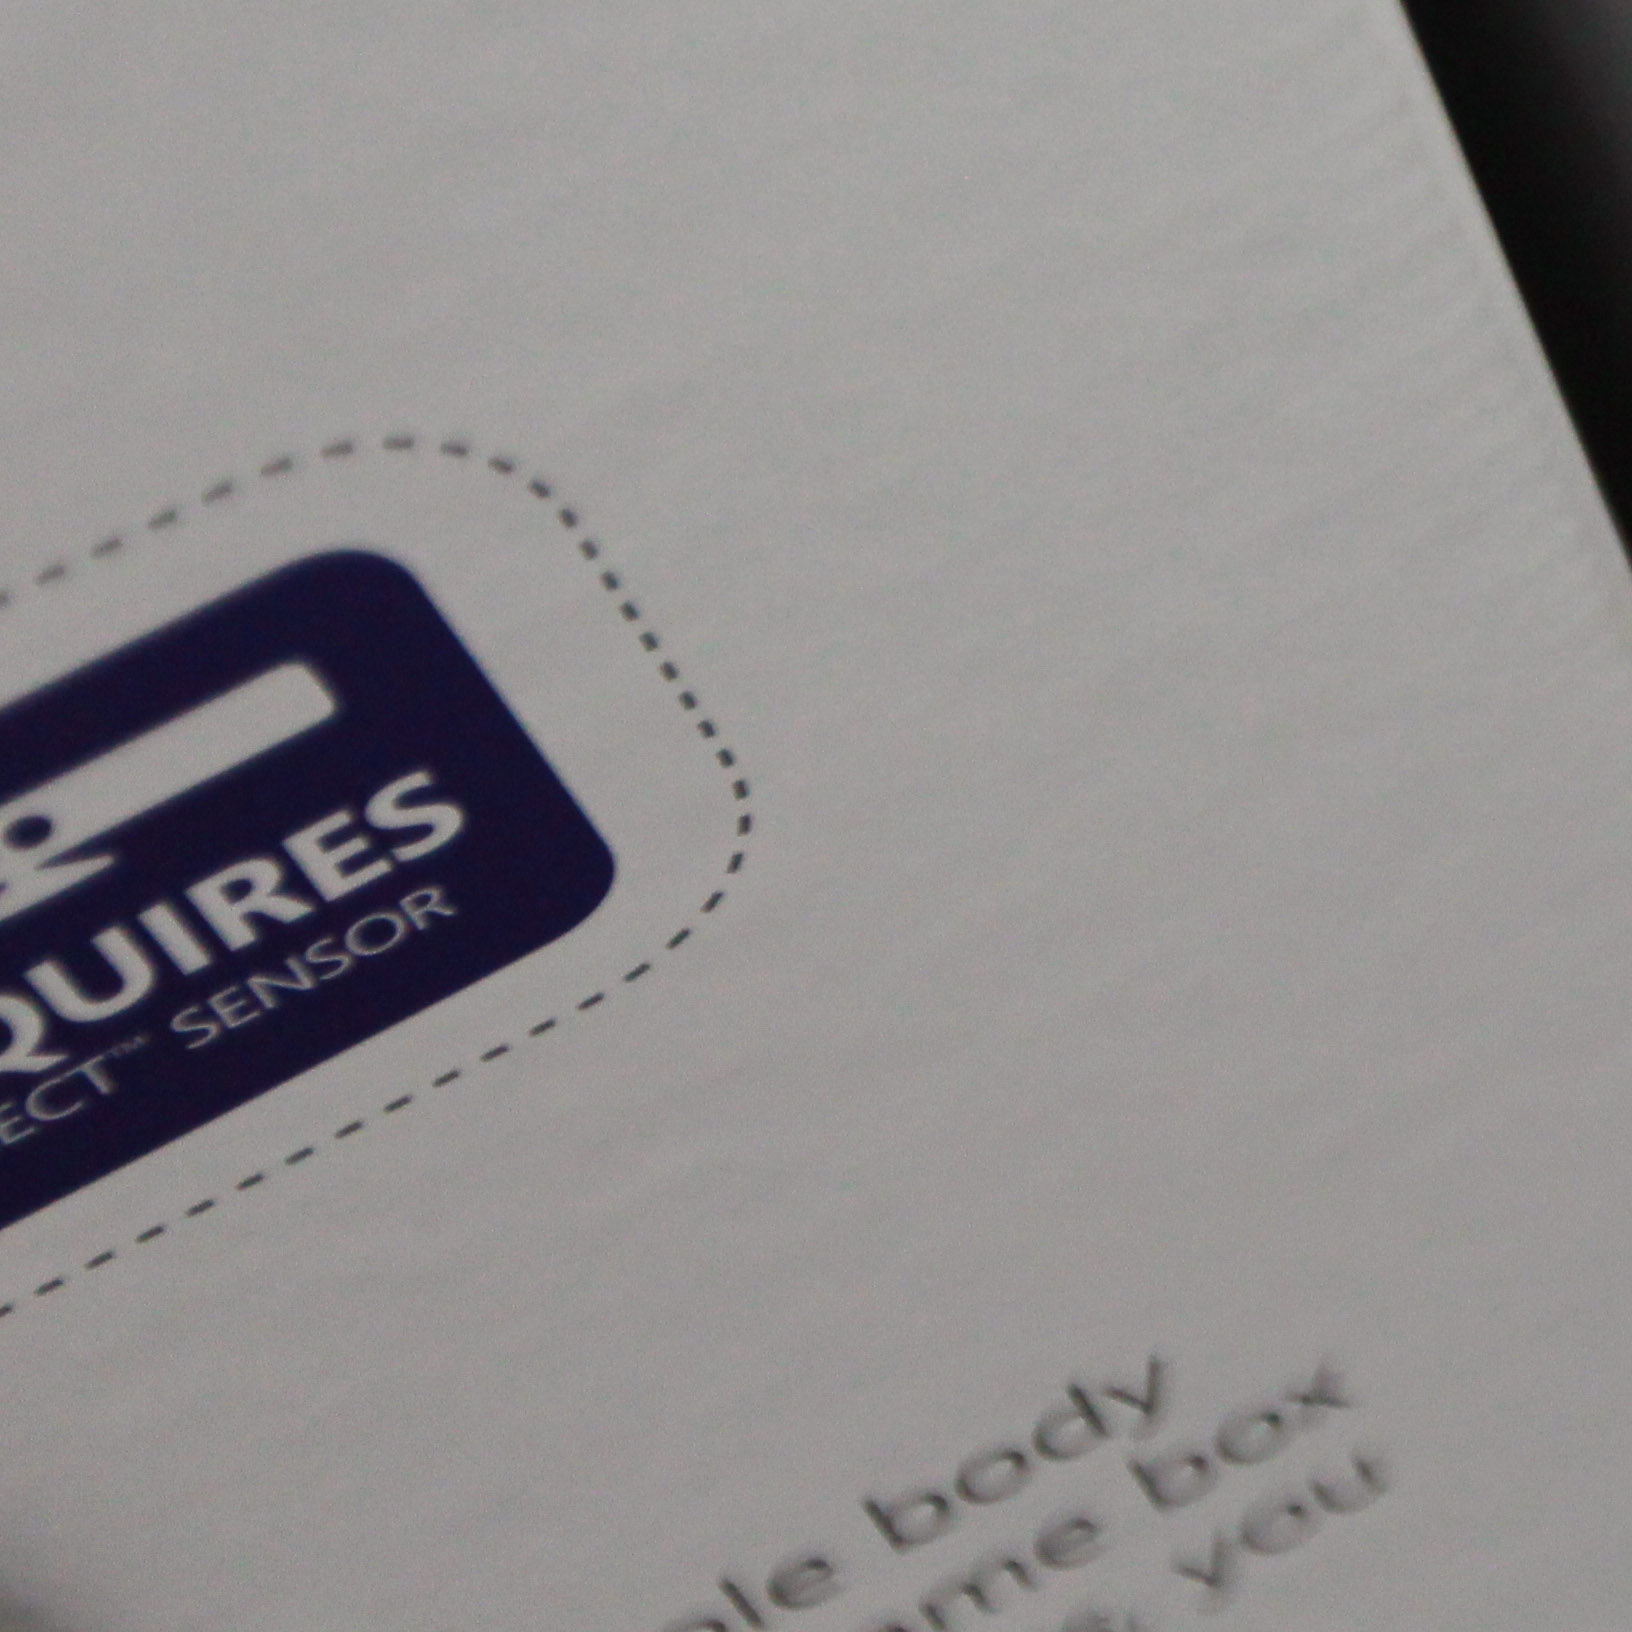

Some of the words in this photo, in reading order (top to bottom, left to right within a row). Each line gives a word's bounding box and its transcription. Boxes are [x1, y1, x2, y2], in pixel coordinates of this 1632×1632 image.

[169, 884, 458, 1050] SENSOR
[660, 1555, 845, 1632] le
[864, 1355, 1168, 1553] body
[872, 1513, 1104, 1632] me
[1129, 1363, 1352, 1515] box
[1174, 1444, 1389, 1613] you
